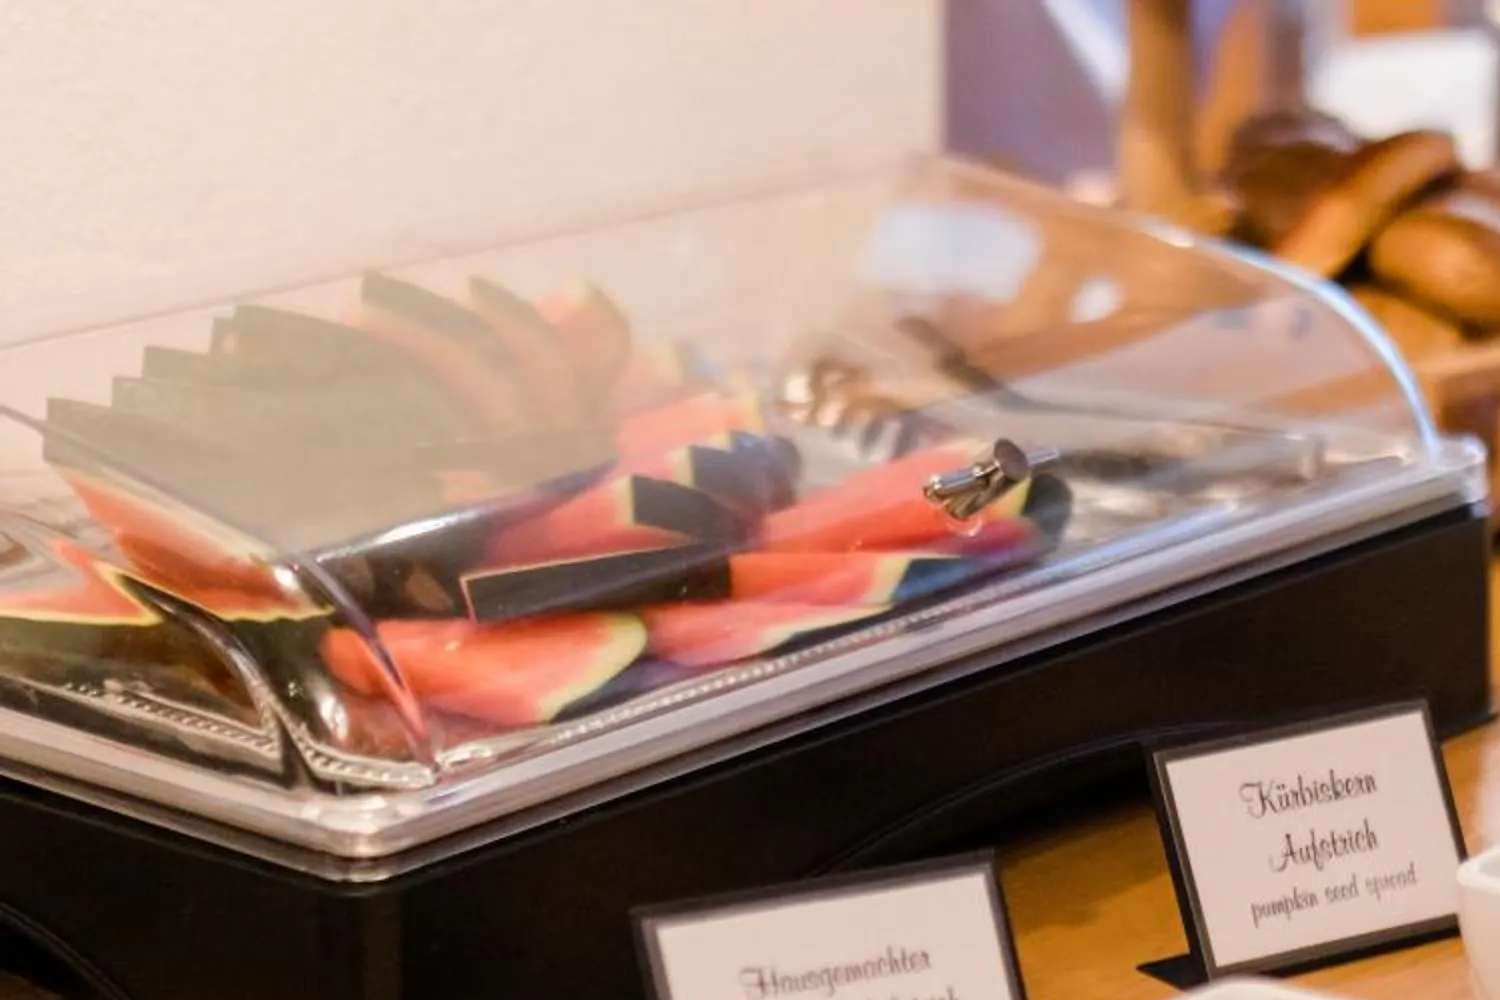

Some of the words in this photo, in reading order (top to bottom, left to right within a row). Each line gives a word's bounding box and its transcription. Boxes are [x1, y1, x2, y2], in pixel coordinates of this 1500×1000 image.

[1239, 769, 1377, 819] Kürbiskern
[1269, 818, 1378, 872] Aufstrich
[1251, 886, 1319, 928] pumpkin
[1325, 873, 1359, 903] seed
[1365, 861, 1417, 902] spread
[738, 946, 932, 1000] Hausgemachter
